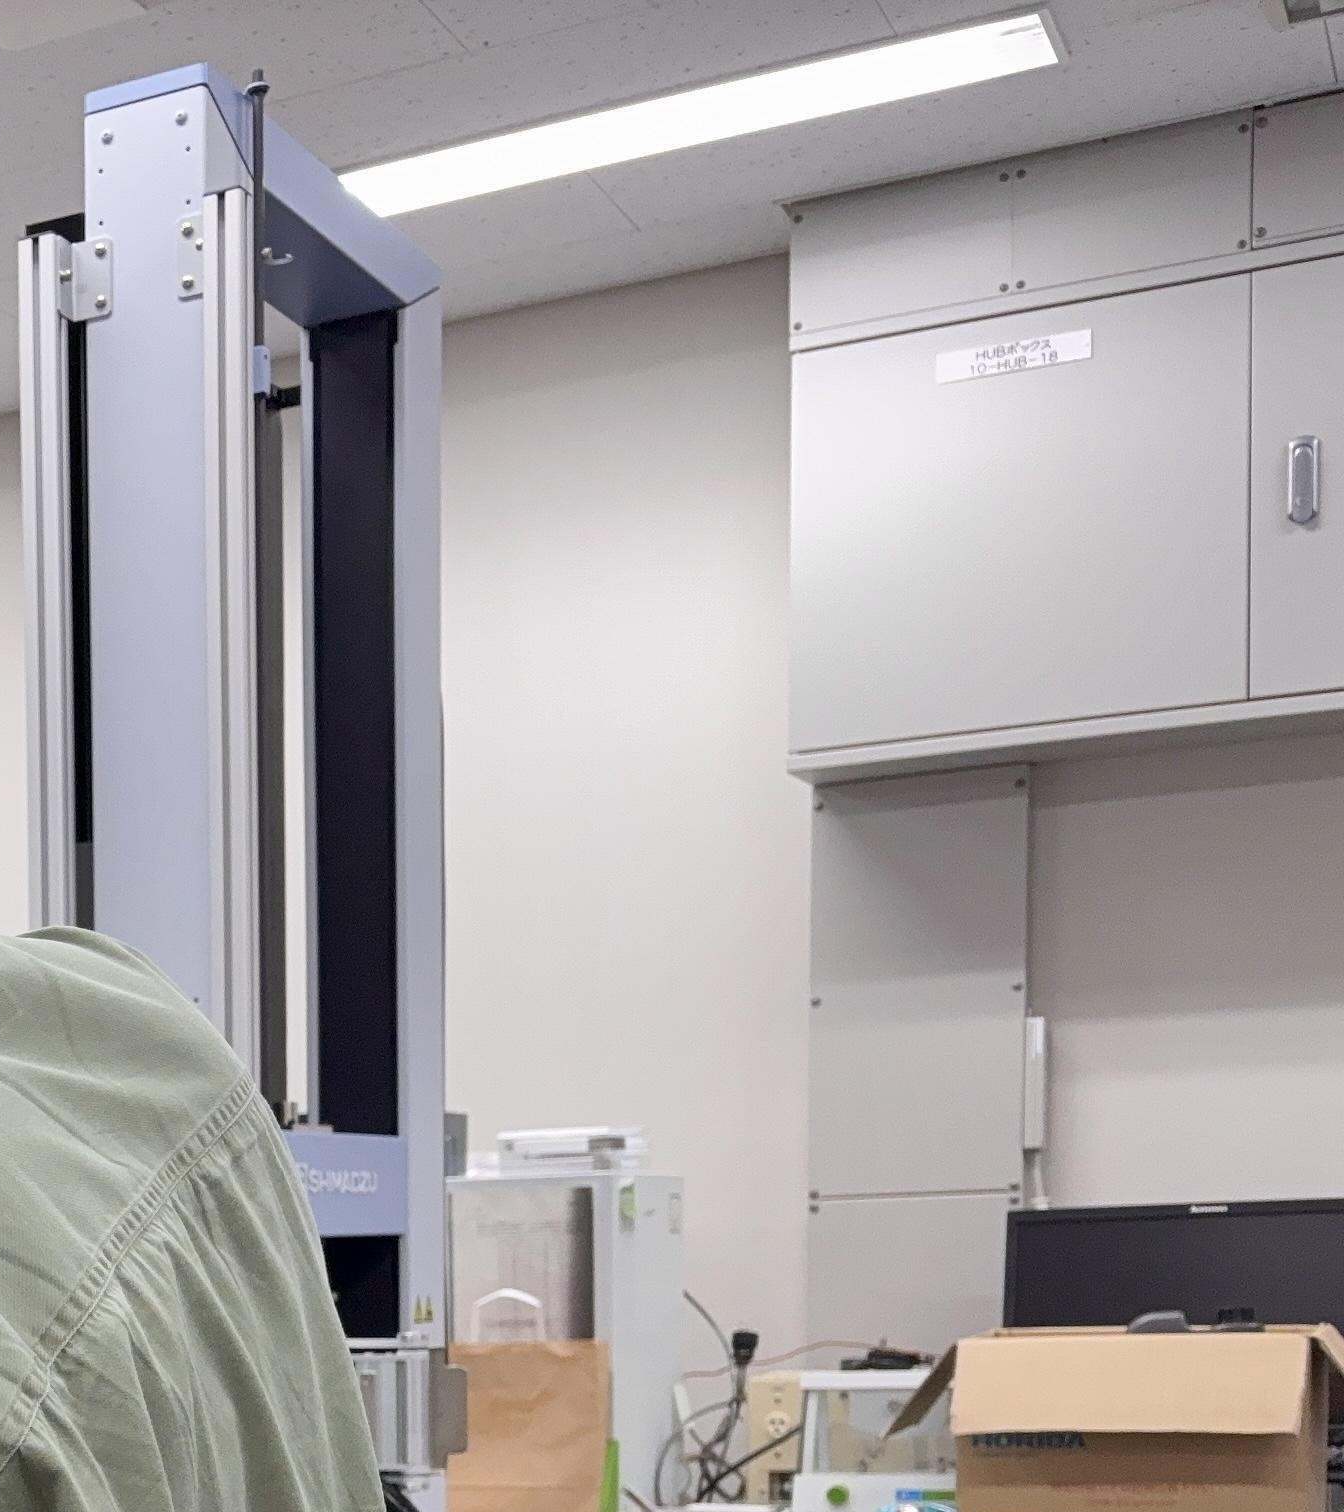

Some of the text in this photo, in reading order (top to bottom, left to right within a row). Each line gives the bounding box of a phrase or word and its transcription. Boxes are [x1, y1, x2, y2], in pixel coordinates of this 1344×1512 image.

[976, 339, 1052, 361] HUBボックス
[969, 350, 1058, 376] 10-HUB-18
